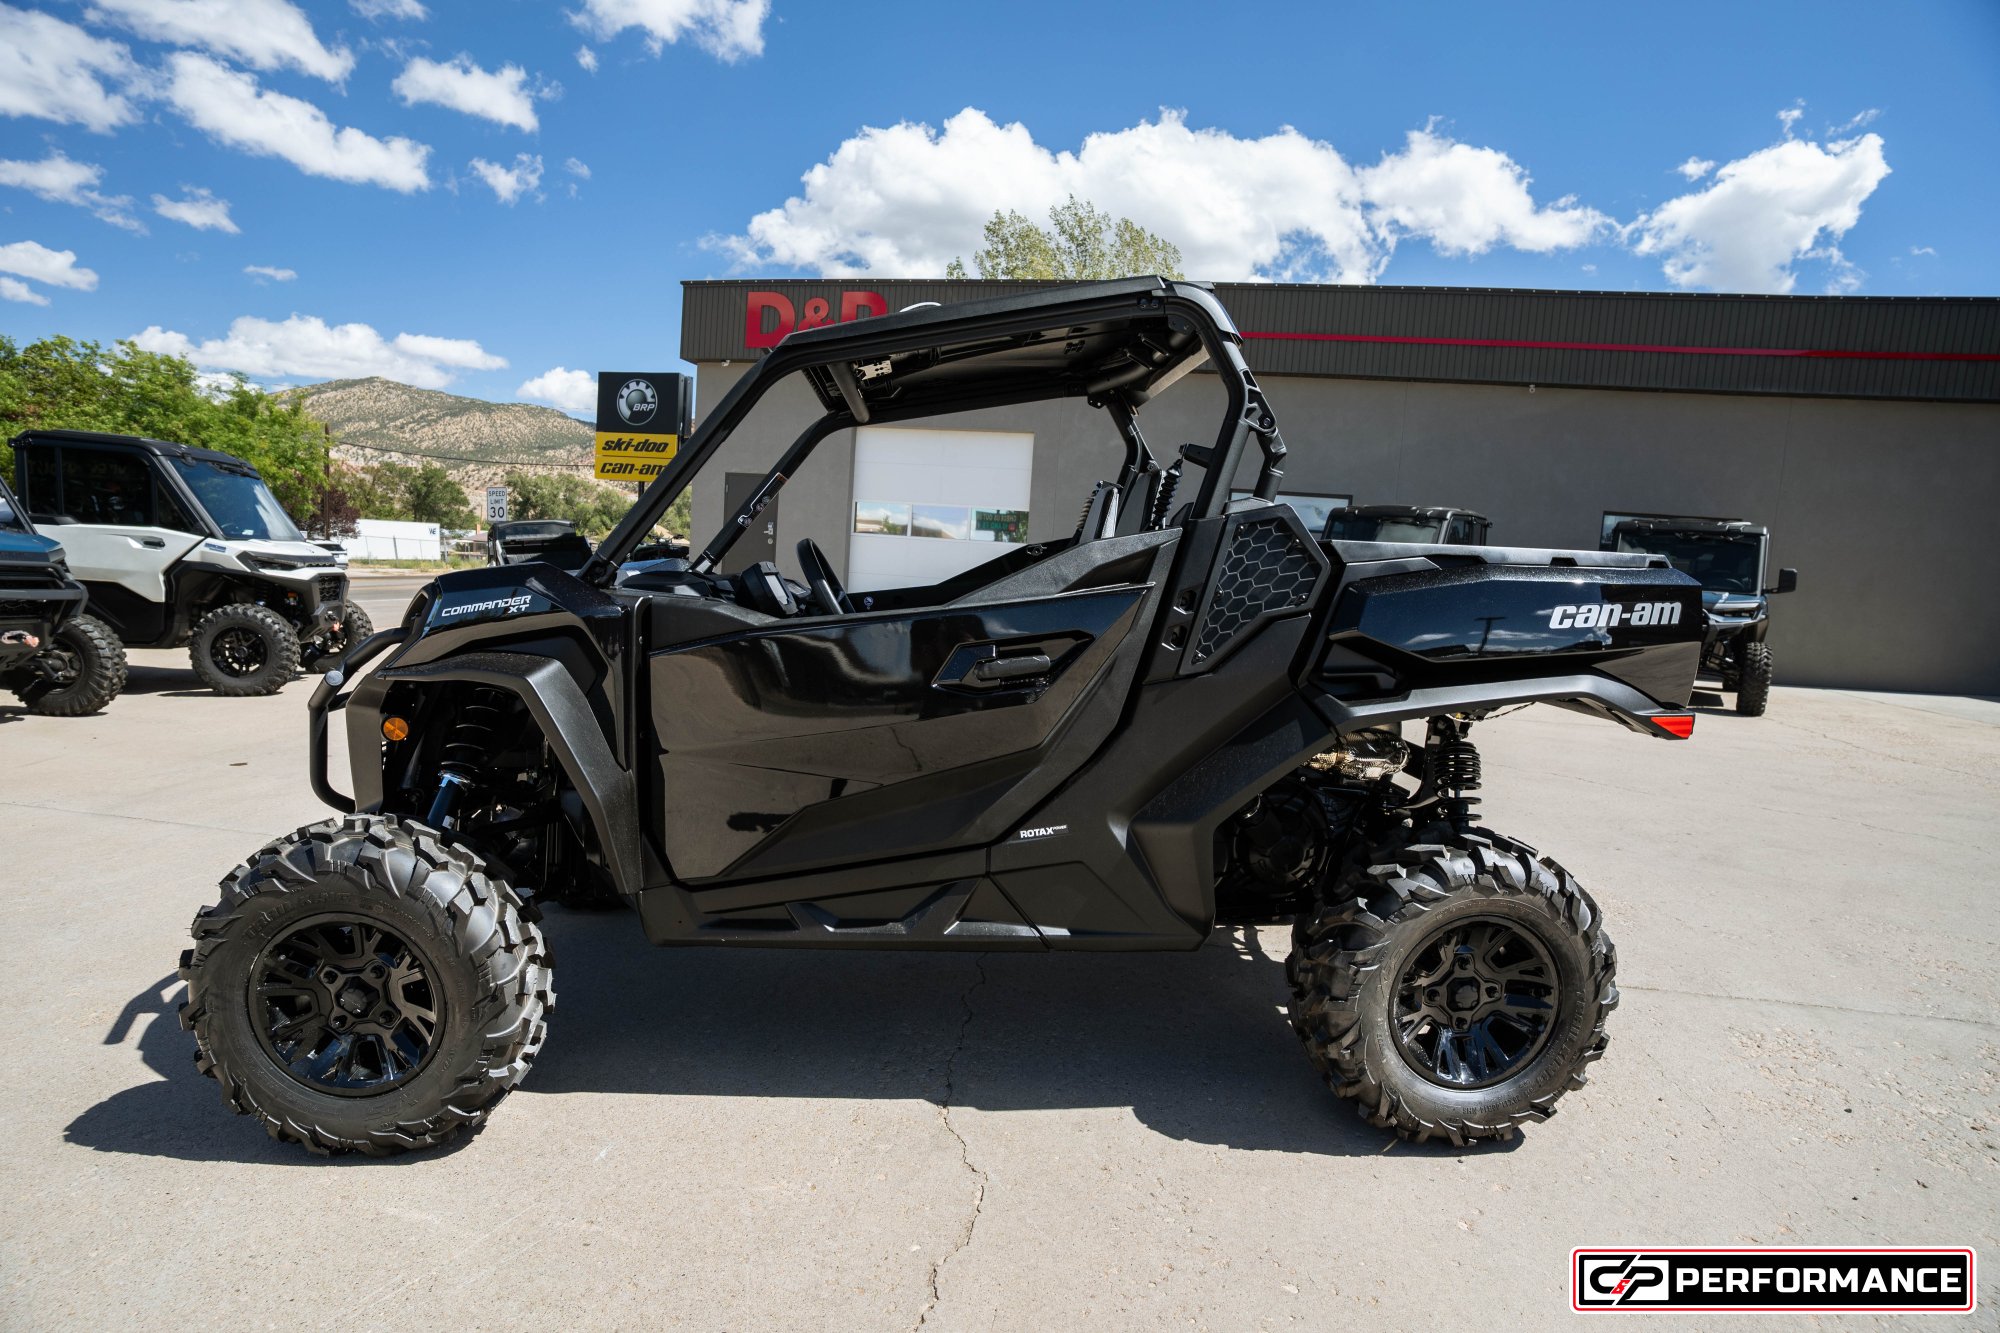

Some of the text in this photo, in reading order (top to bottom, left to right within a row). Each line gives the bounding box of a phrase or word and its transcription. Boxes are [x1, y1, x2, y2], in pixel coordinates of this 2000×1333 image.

[632, 403, 656, 412] BRP
[602, 437, 669, 453] ski-doo
[489, 506, 505, 518] 30
[441, 595, 532, 617] COMMANDER
[507, 603, 530, 614] XT
[1549, 602, 1682, 629] can-am
[1019, 826, 1054, 839] ROTAX
